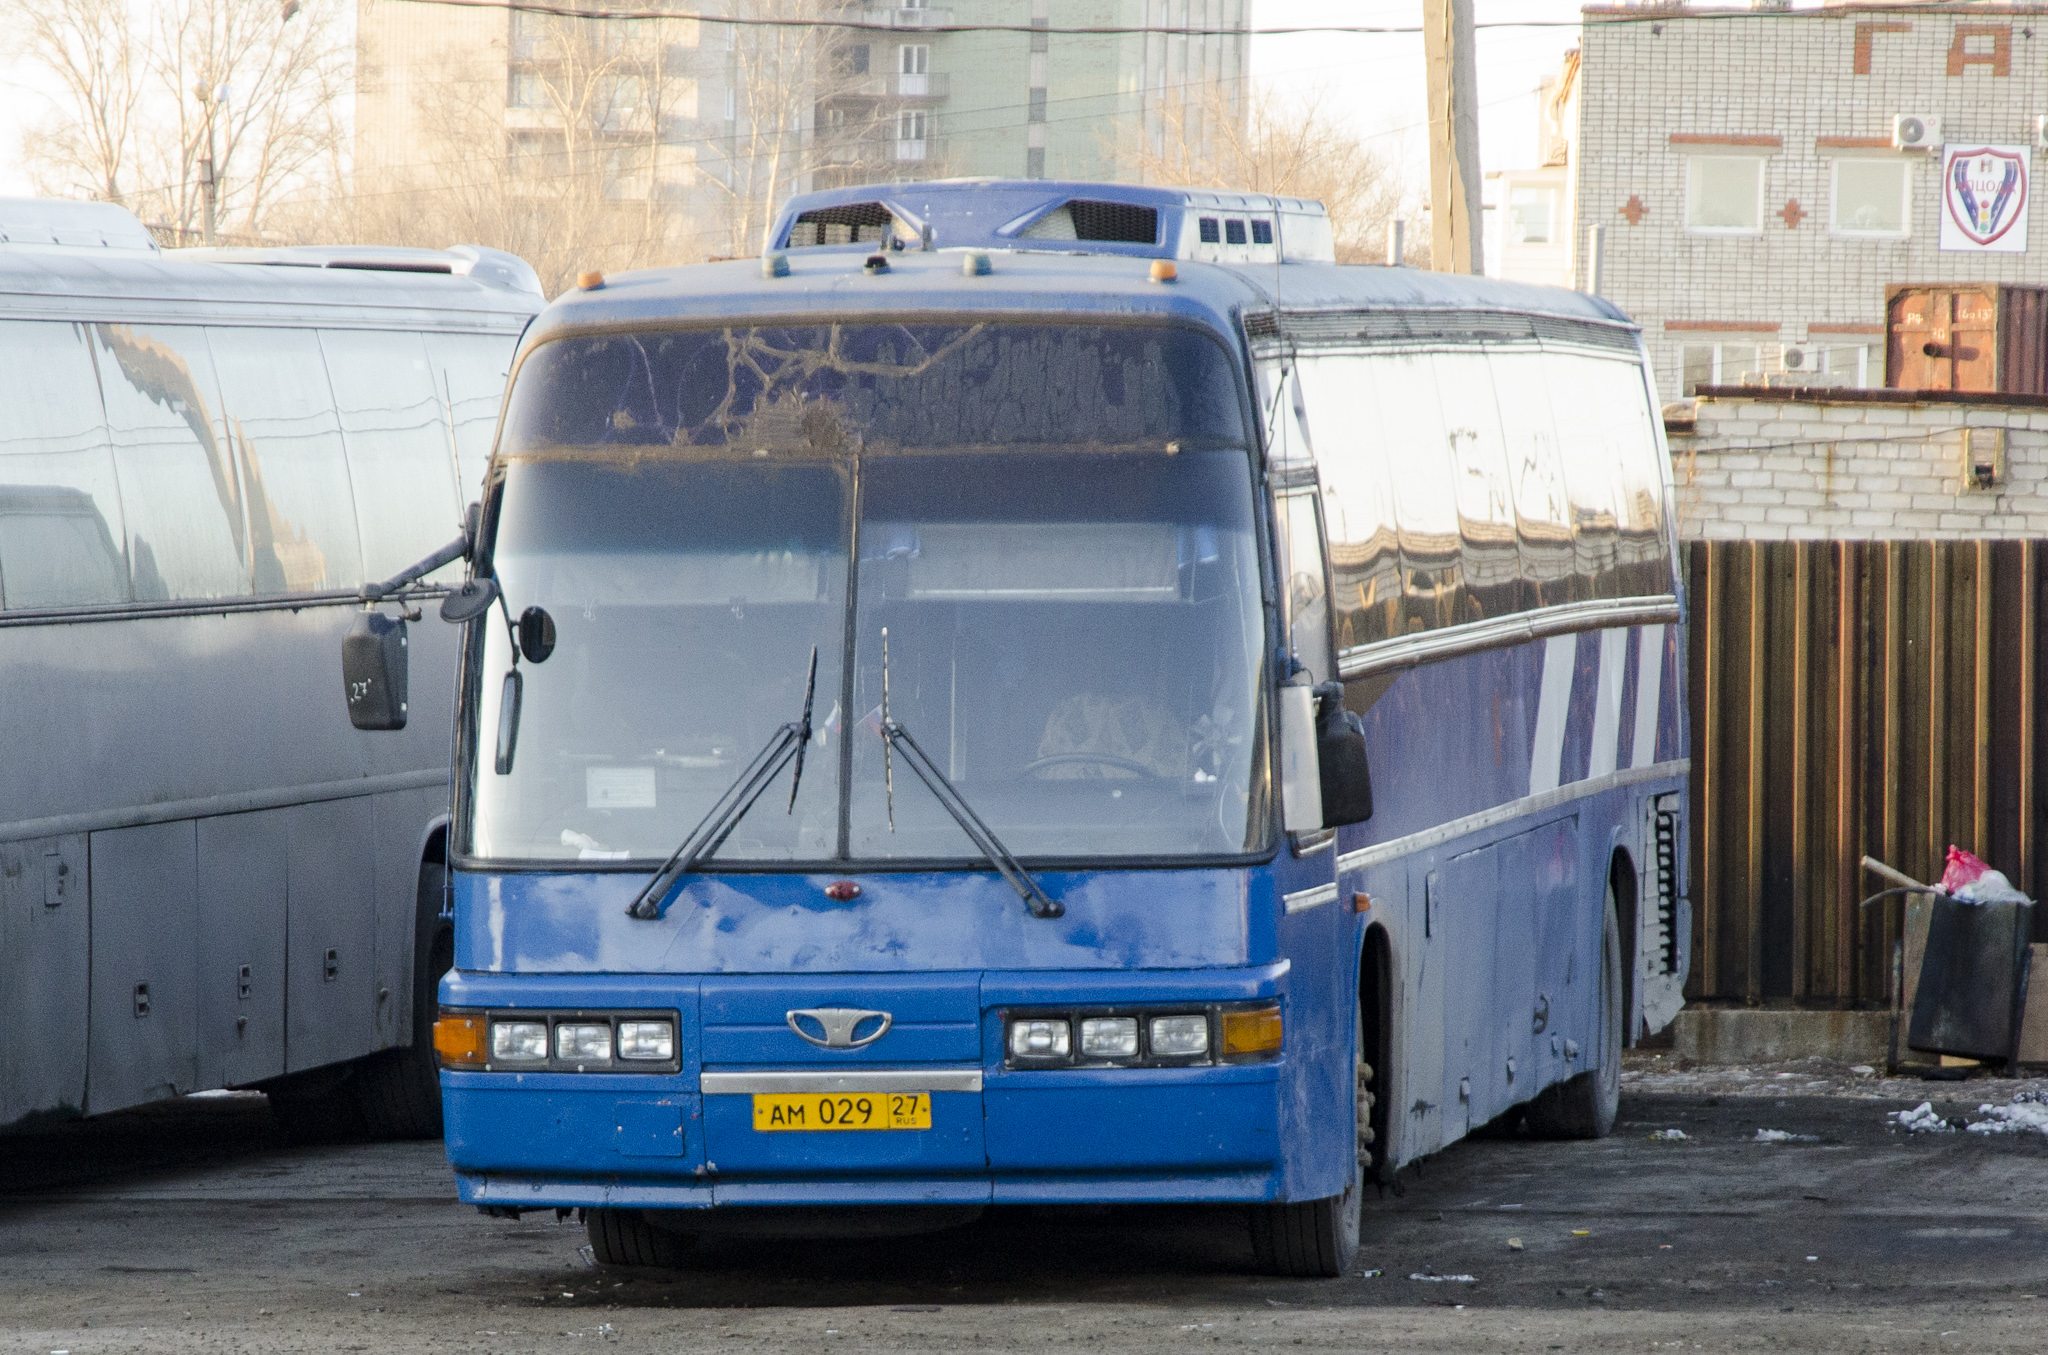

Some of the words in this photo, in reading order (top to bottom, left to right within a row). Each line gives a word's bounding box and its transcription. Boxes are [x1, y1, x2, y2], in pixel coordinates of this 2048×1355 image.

[818, 1097, 873, 1125] 029
[892, 1095, 919, 1116] 27
[896, 1116, 917, 1125] RUS
